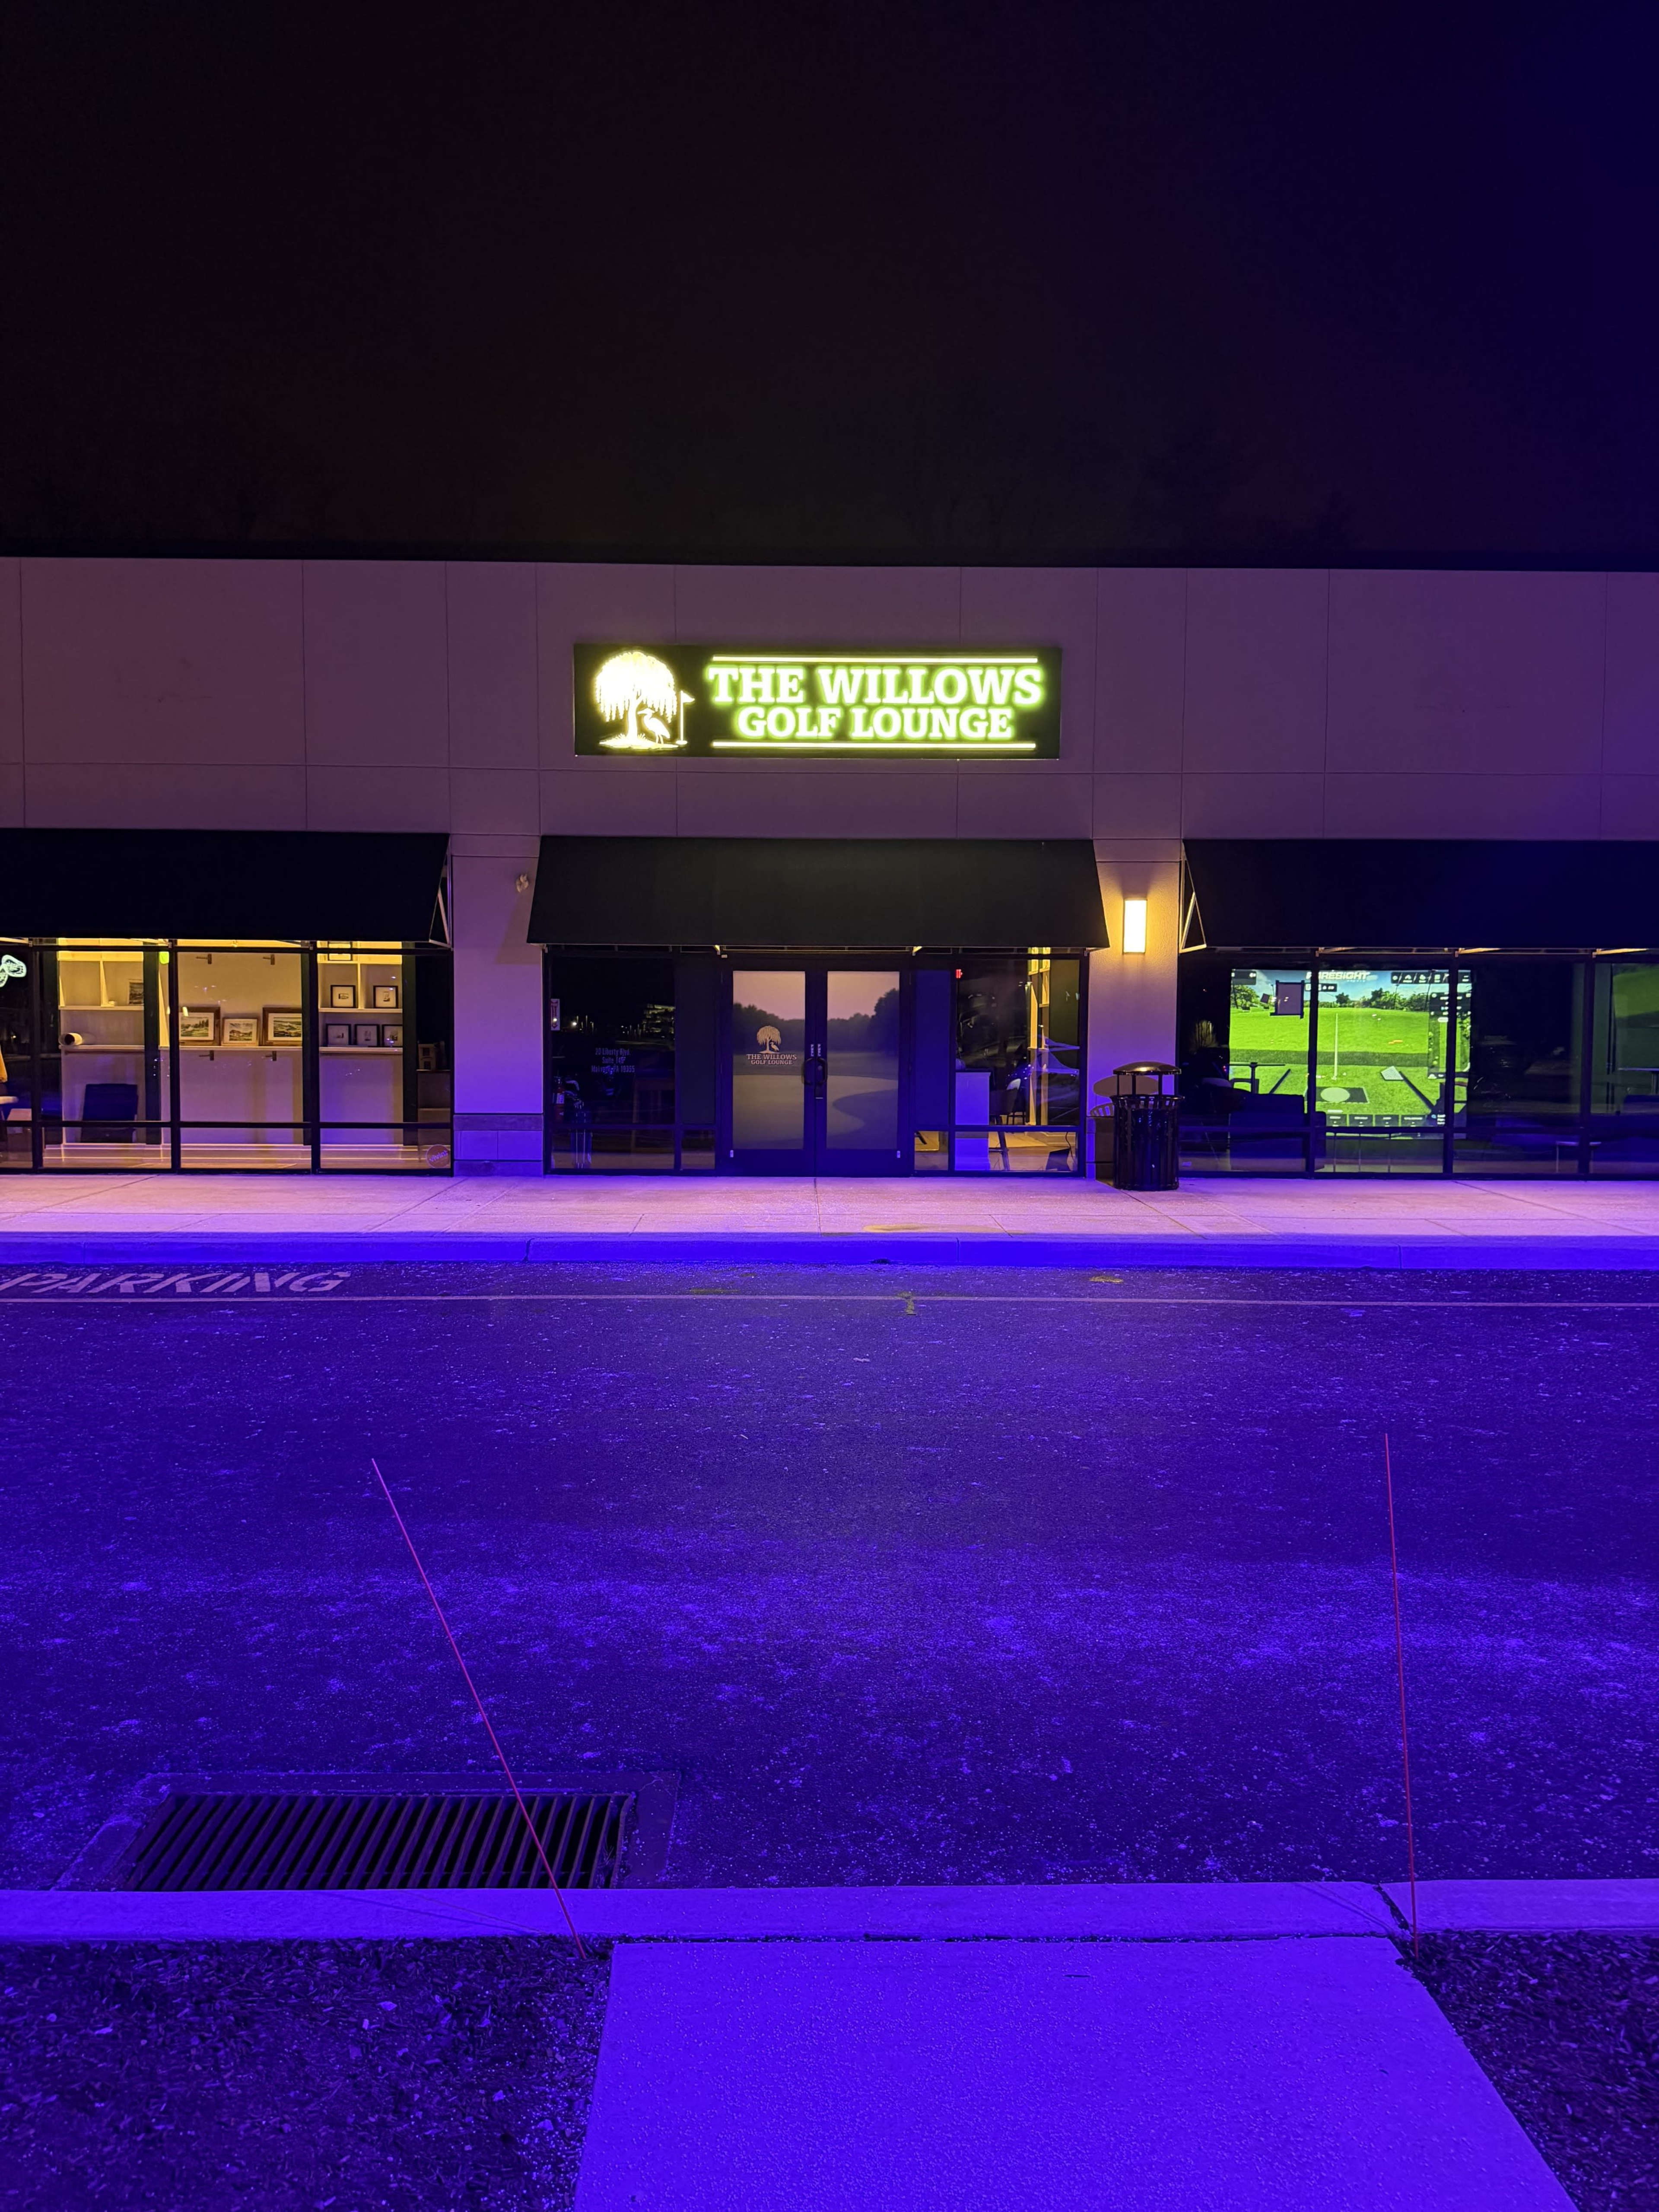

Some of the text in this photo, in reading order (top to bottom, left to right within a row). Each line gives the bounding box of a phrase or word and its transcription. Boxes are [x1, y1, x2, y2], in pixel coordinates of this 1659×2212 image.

[707, 667, 1044, 705] THE WILLOWS
[737, 707, 1014, 740] GOLF LOUNGE
[0, 1273, 351, 1293] PARKING
